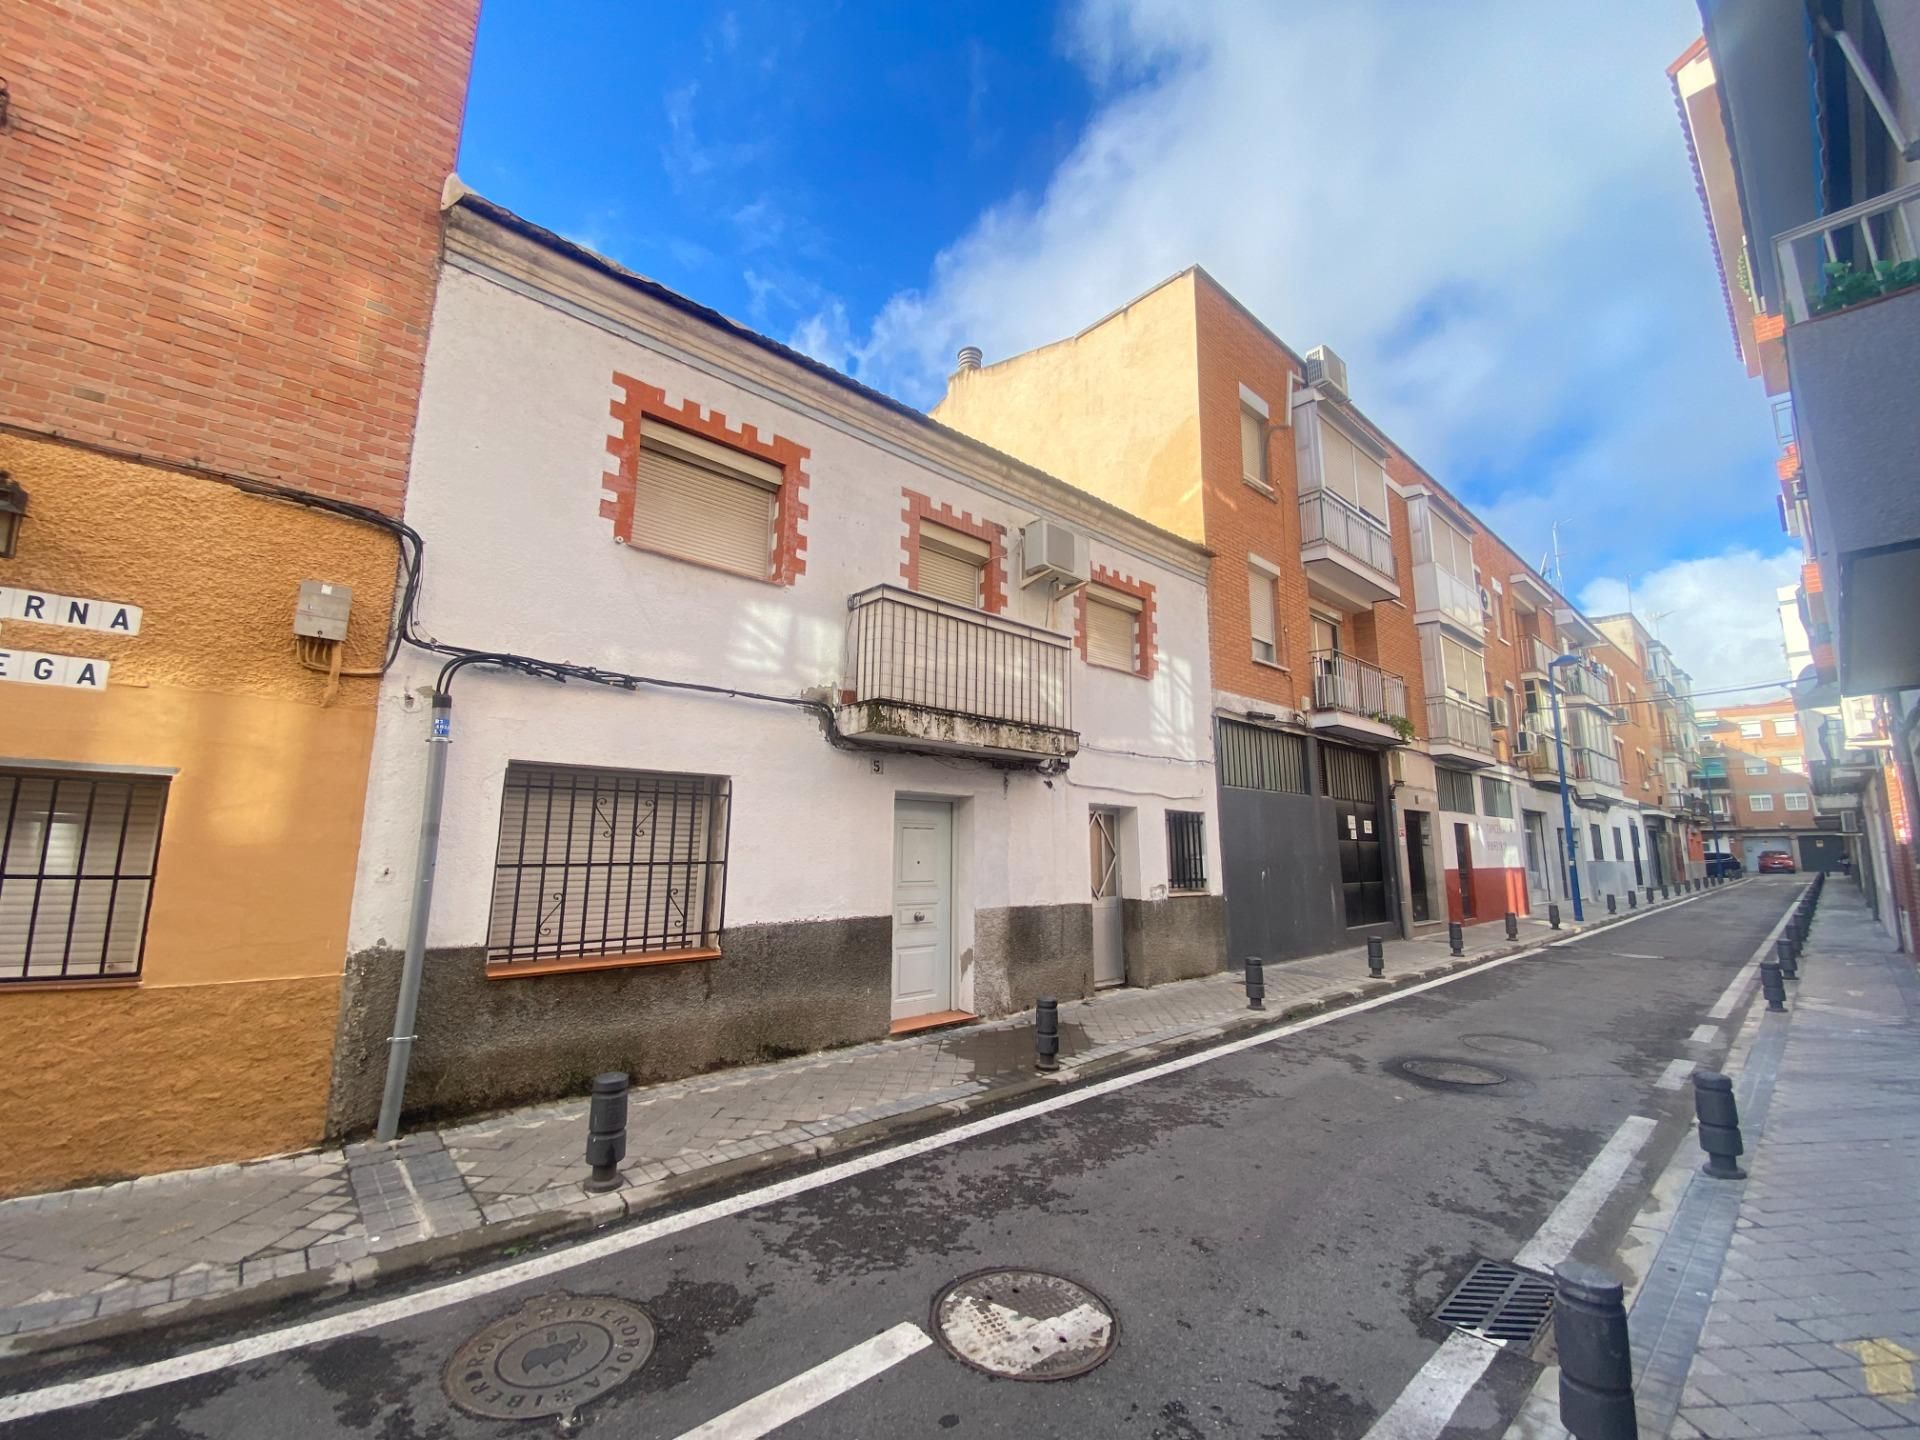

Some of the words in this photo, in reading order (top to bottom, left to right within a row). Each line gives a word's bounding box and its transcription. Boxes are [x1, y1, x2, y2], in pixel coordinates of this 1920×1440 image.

[0, 591, 129, 631] RNA
[873, 760, 881, 773] 5
[464, 1321, 544, 1408] IBERDROLA
[566, 1307, 642, 1389] IBERDROLA
